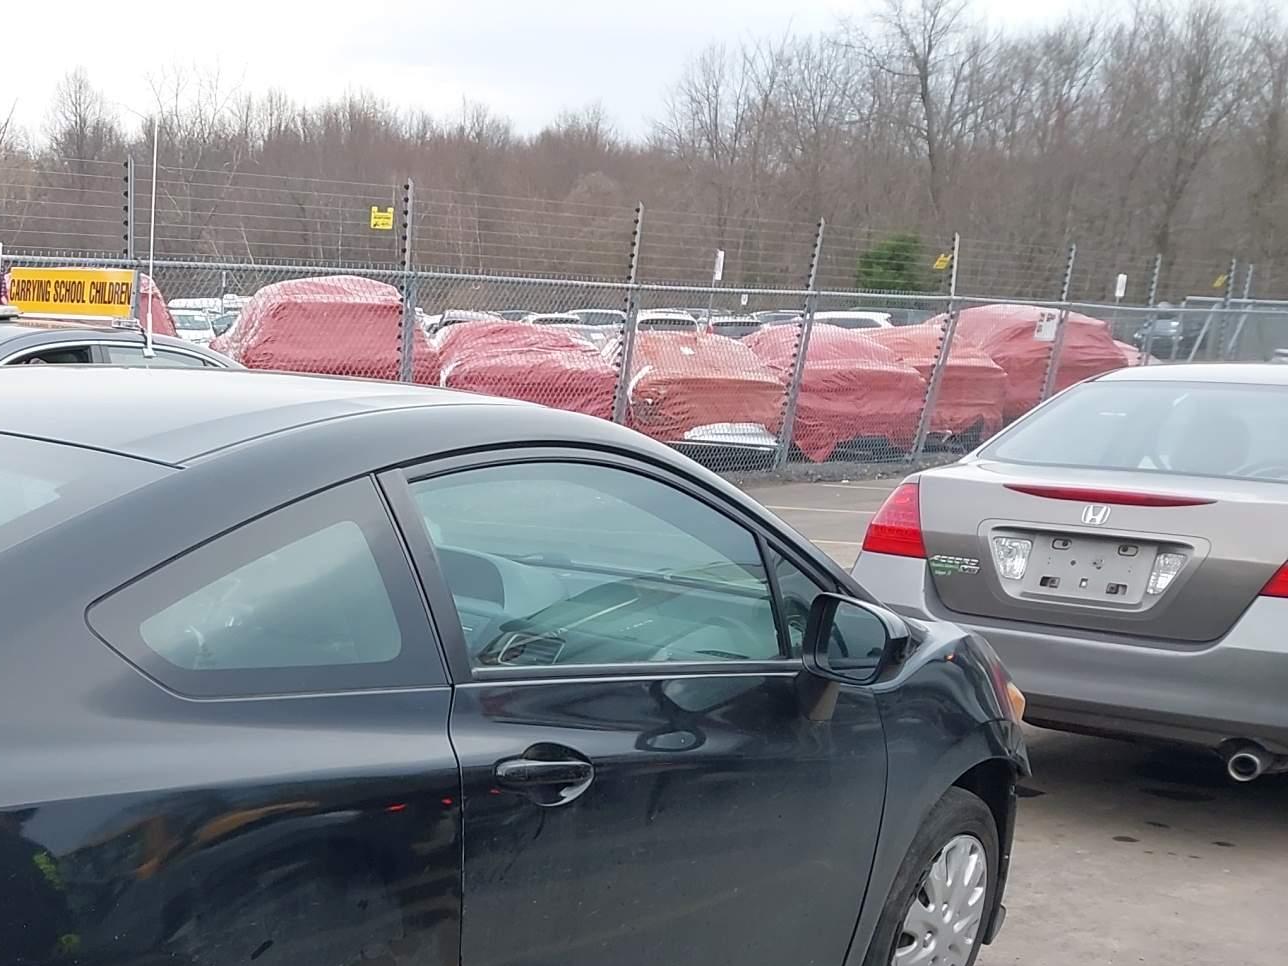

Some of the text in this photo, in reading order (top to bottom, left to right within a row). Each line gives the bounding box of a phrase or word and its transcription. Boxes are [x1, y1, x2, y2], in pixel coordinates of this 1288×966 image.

[10, 279, 132, 305] CARRYING SCHOOL CHILDREN
